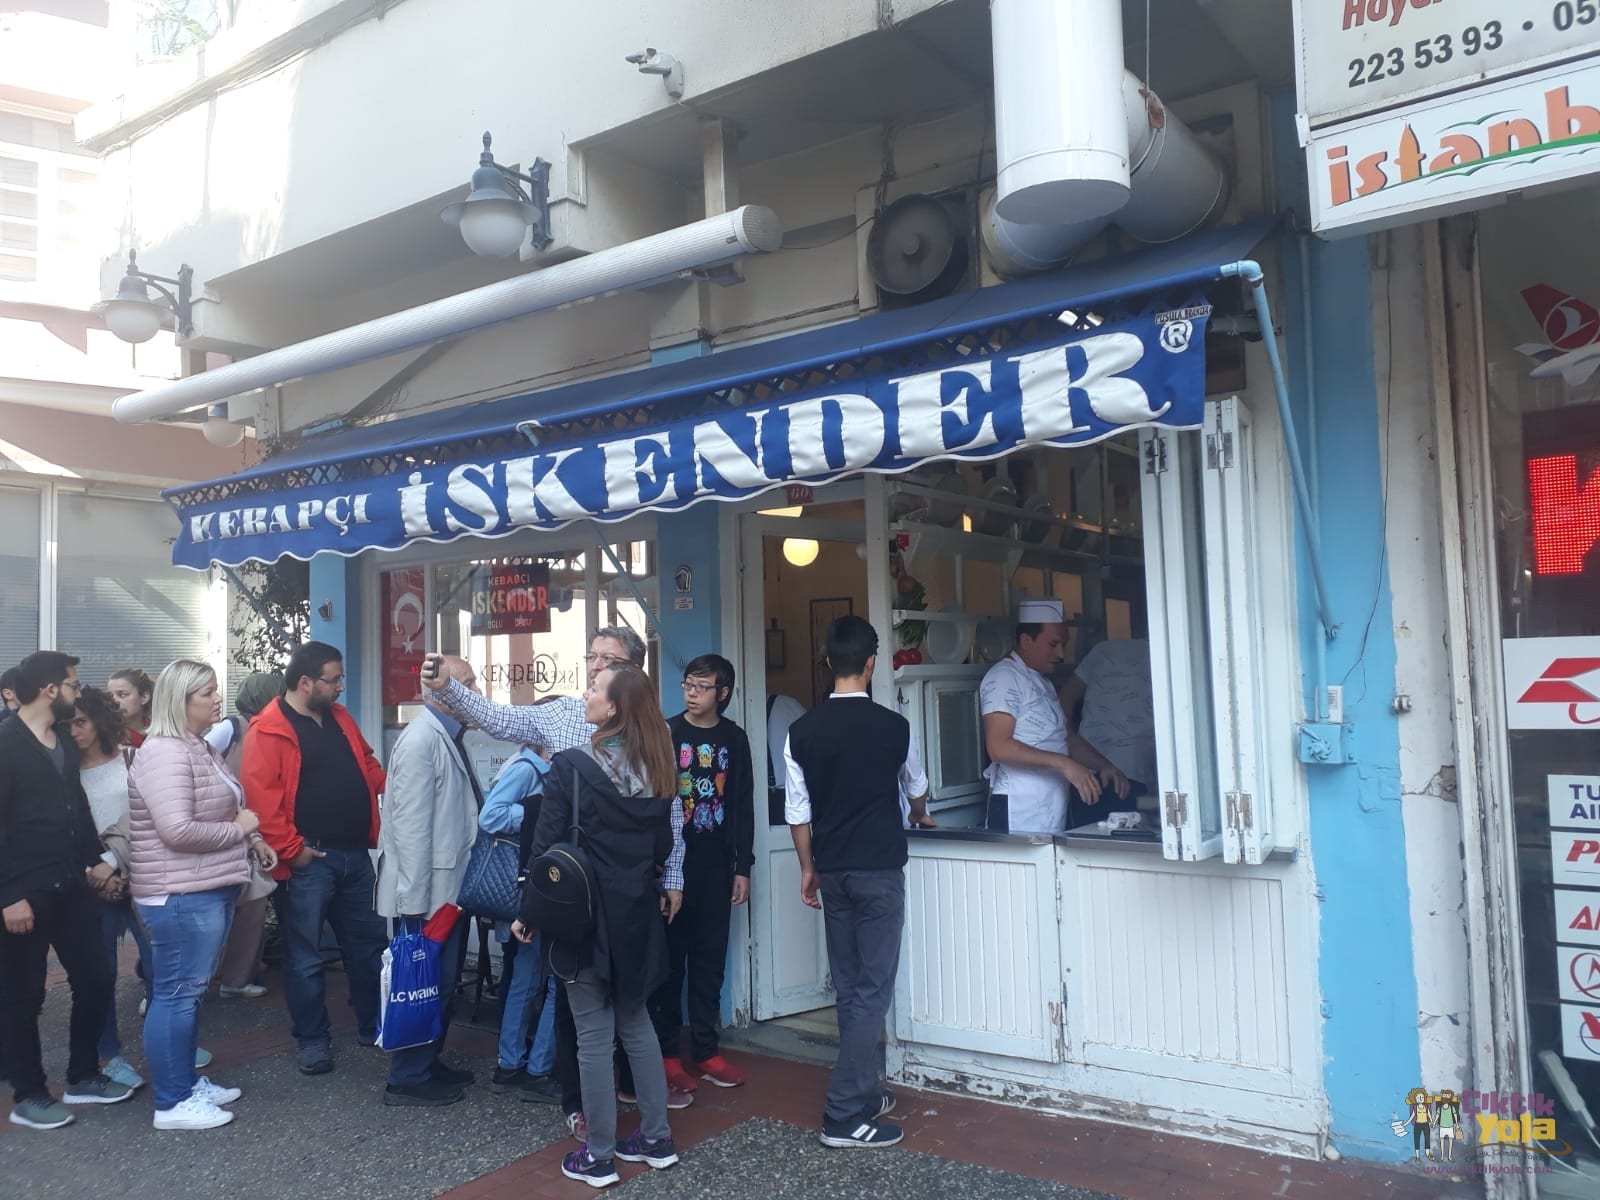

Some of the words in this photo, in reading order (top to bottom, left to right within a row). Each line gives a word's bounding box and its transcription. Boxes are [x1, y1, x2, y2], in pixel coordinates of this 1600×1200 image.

[1348, 48, 1404, 88] 223
[1414, 34, 1453, 69] 53
[1462, 20, 1503, 56] 93
[1553, 0, 1600, 31] 05
[190, 493, 371, 544] KEBAPÇI
[398, 332, 1172, 538] İSKENDER
[1569, 784, 1600, 801] TU
[1570, 803, 1600, 819] AI
[1566, 839, 1600, 863] P
[390, 991, 407, 1004] LC
